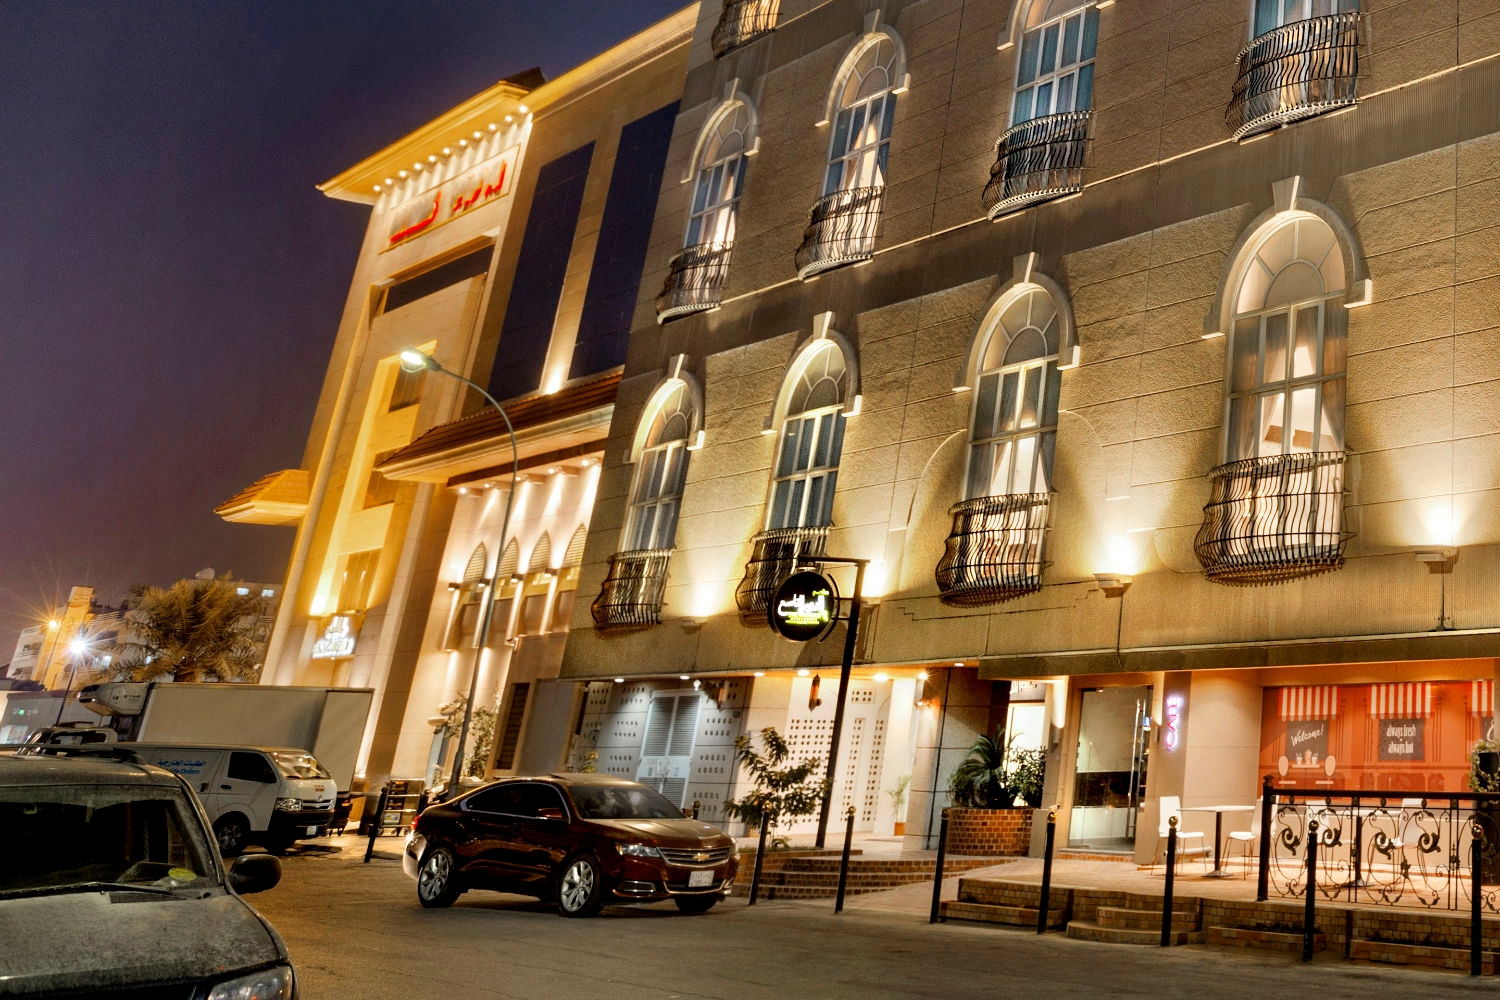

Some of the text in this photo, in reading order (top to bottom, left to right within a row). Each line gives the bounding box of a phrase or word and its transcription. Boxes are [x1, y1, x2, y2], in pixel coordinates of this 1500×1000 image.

[1291, 723, 1324, 747] Welcome!
[1386, 724, 1416, 738] always fresh
[1388, 741, 1414, 755] always hot
